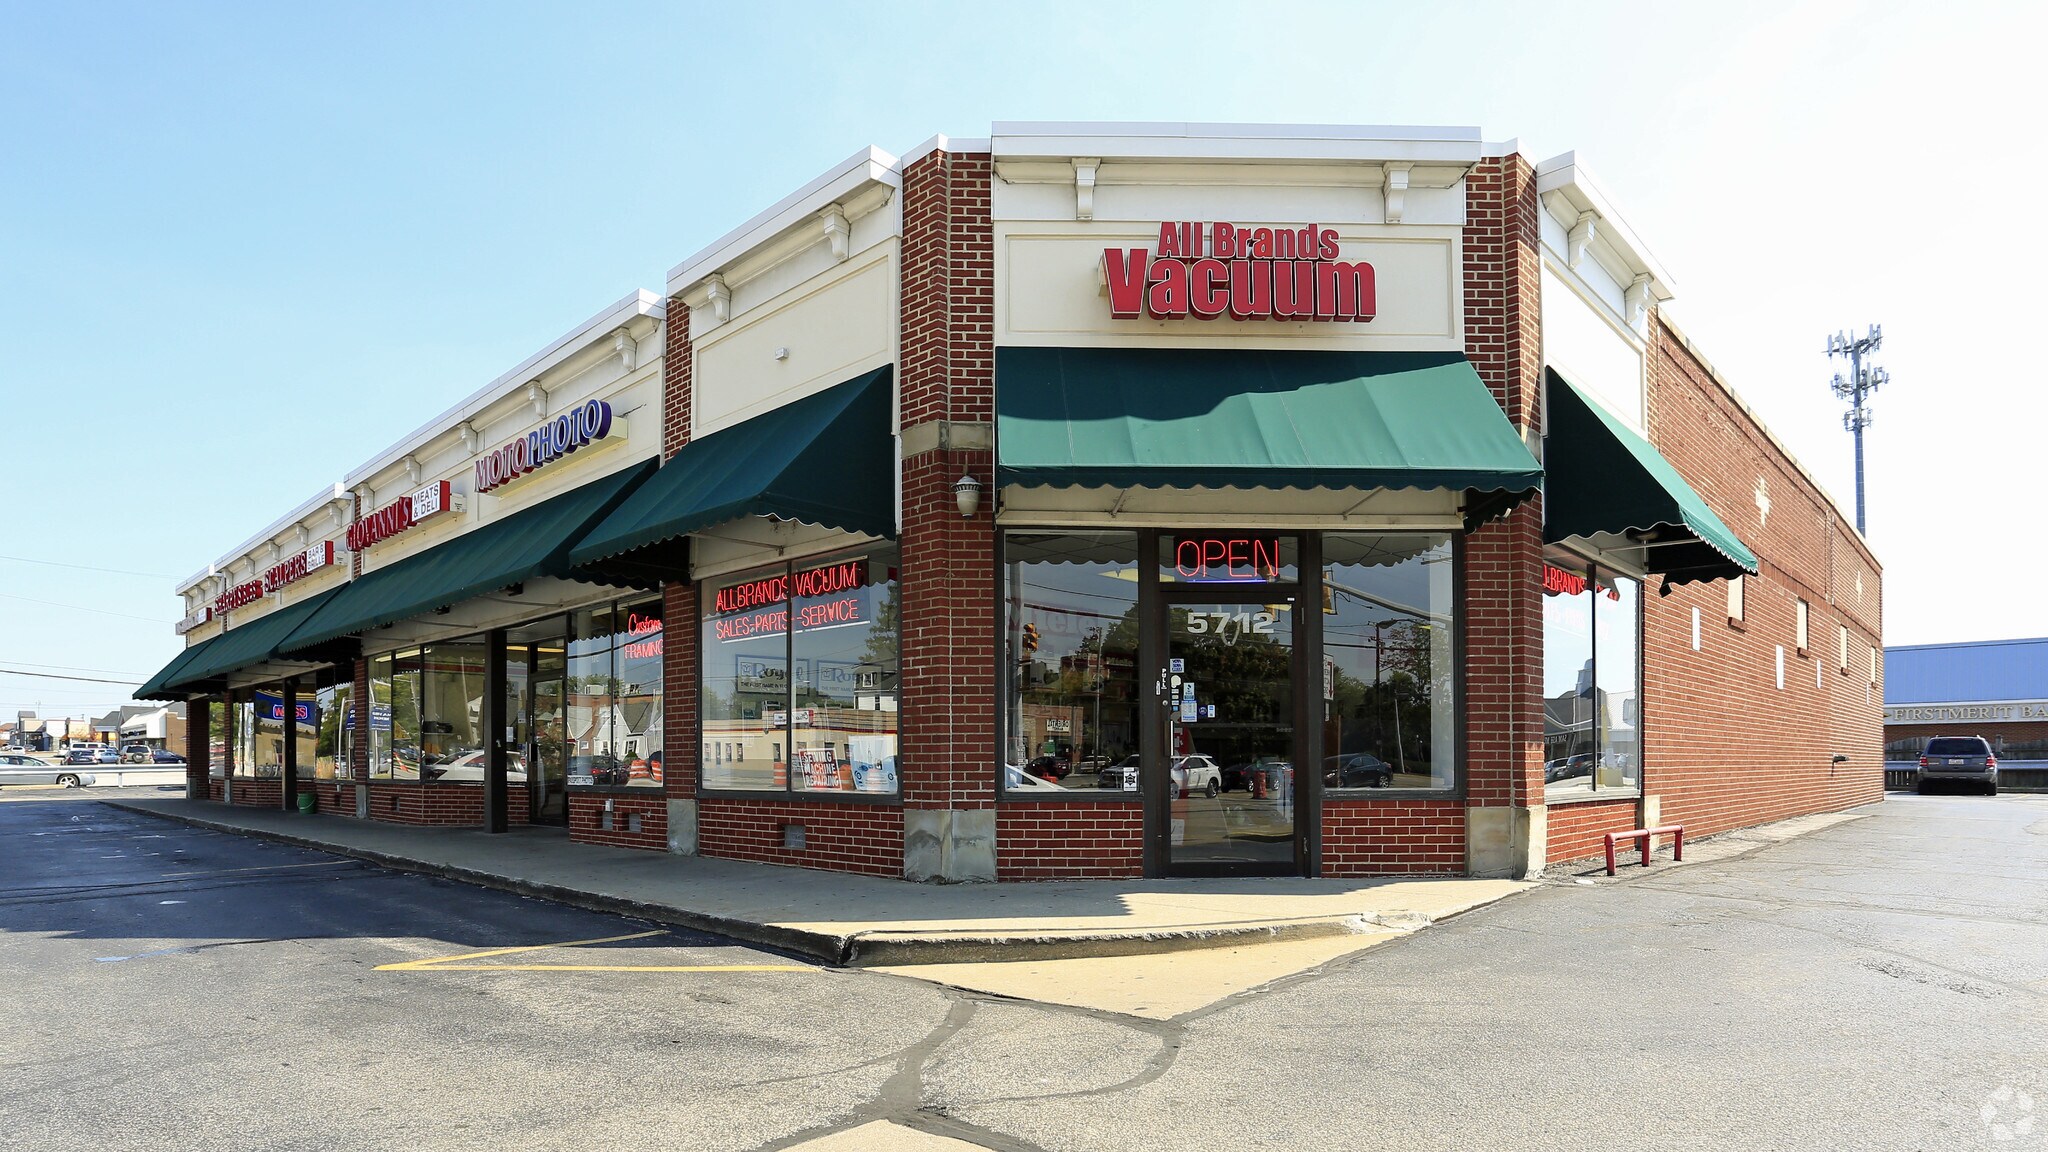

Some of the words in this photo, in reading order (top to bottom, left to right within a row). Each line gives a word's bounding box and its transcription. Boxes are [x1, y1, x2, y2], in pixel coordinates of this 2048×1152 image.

[1157, 221, 1205, 257] All
[1211, 221, 1341, 260] Brands
[1104, 247, 1378, 320] Vacuum
[475, 399, 606, 493] MOTOPHOTO
[413, 484, 439, 506] MEATS
[413, 508, 419, 518] &
[420, 499, 439, 514] DELI
[1177, 539, 1279, 577] OPEN
[264, 551, 307, 592] SCALPERS
[795, 561, 857, 597] VACUUM
[1186, 612, 1275, 634] 5712
[1894, 705, 2013, 721] FIRSTMERIT
[803, 751, 832, 763] SEWING
[803, 763, 836, 775] MACHINE
[805, 774, 839, 787] REPAIRING
